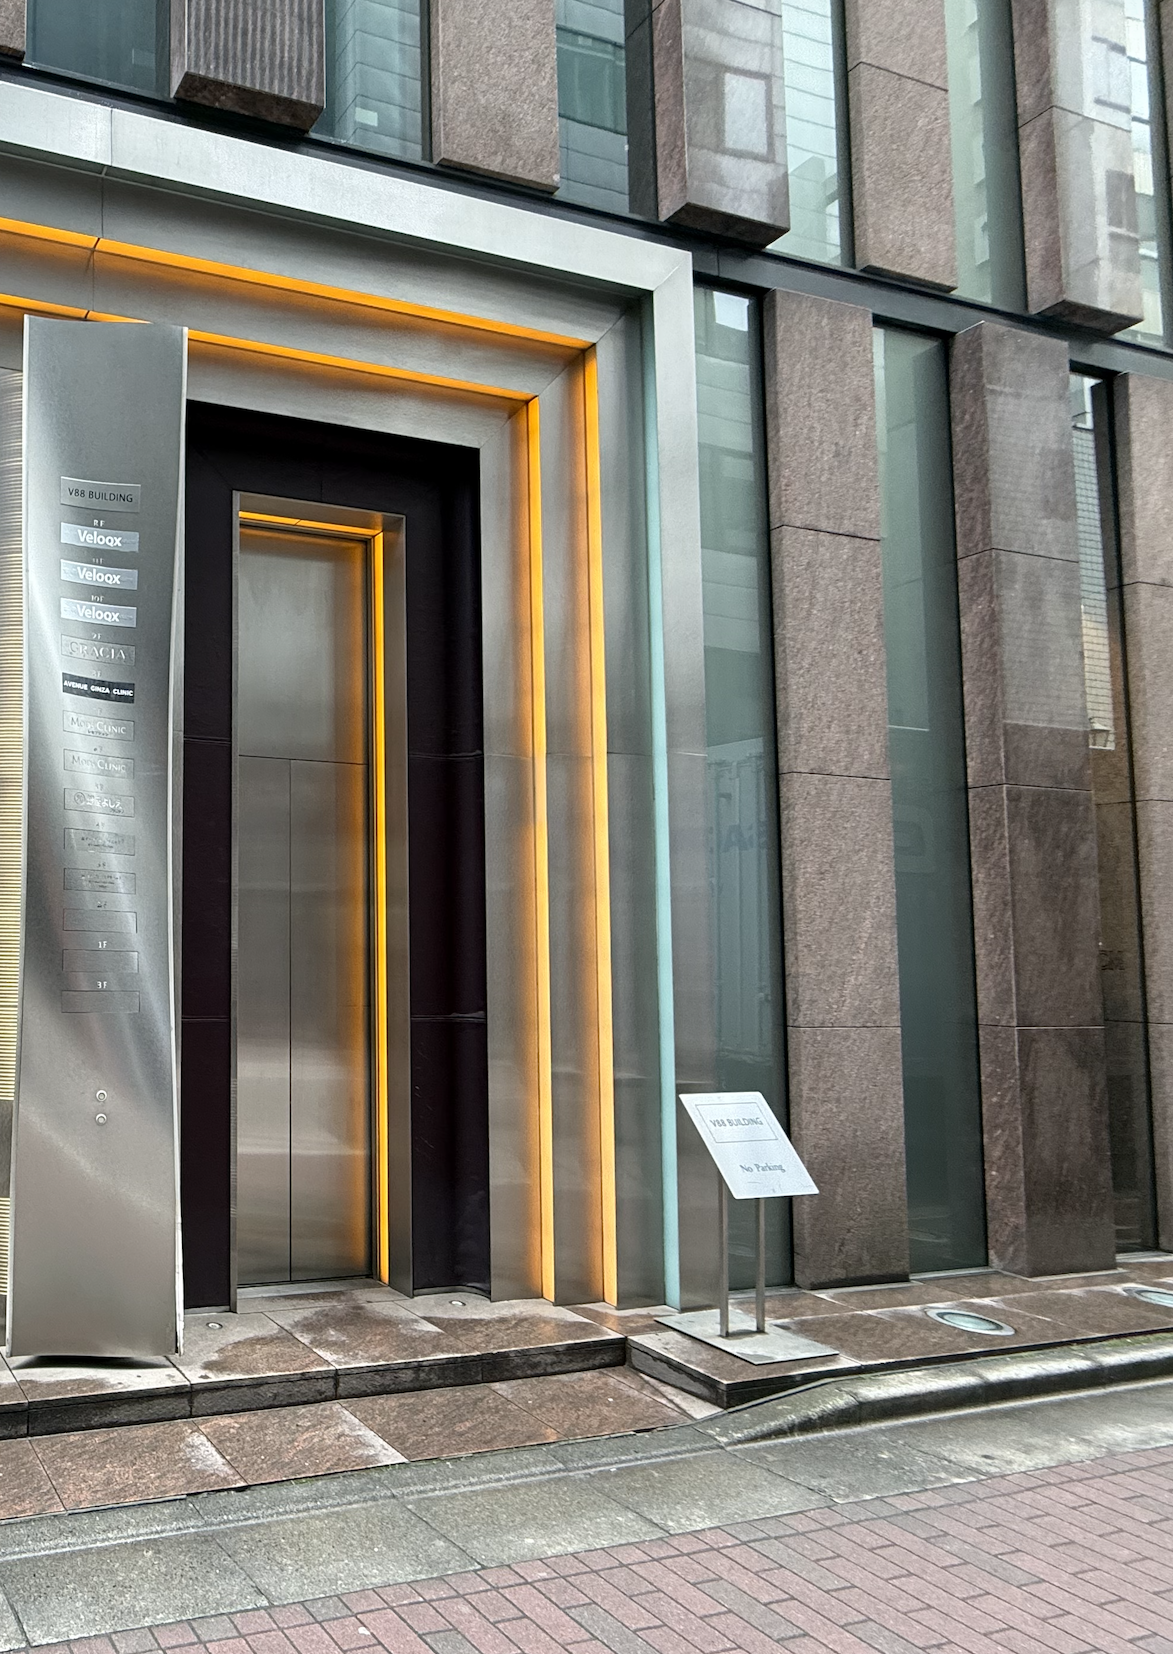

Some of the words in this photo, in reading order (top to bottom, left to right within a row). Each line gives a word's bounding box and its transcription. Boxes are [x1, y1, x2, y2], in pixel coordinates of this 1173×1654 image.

[68, 487, 86, 498] V88
[88, 490, 134, 503] BUILDING
[69, 641, 126, 660] GRACIA
[63, 680, 89, 691] AVENUE
[90, 685, 110, 694] GINZA
[112, 688, 134, 697] CLINIC
[726, 1117, 764, 1127] BUILDING
[739, 1164, 753, 1173] No
[754, 1162, 786, 1174] Parking
